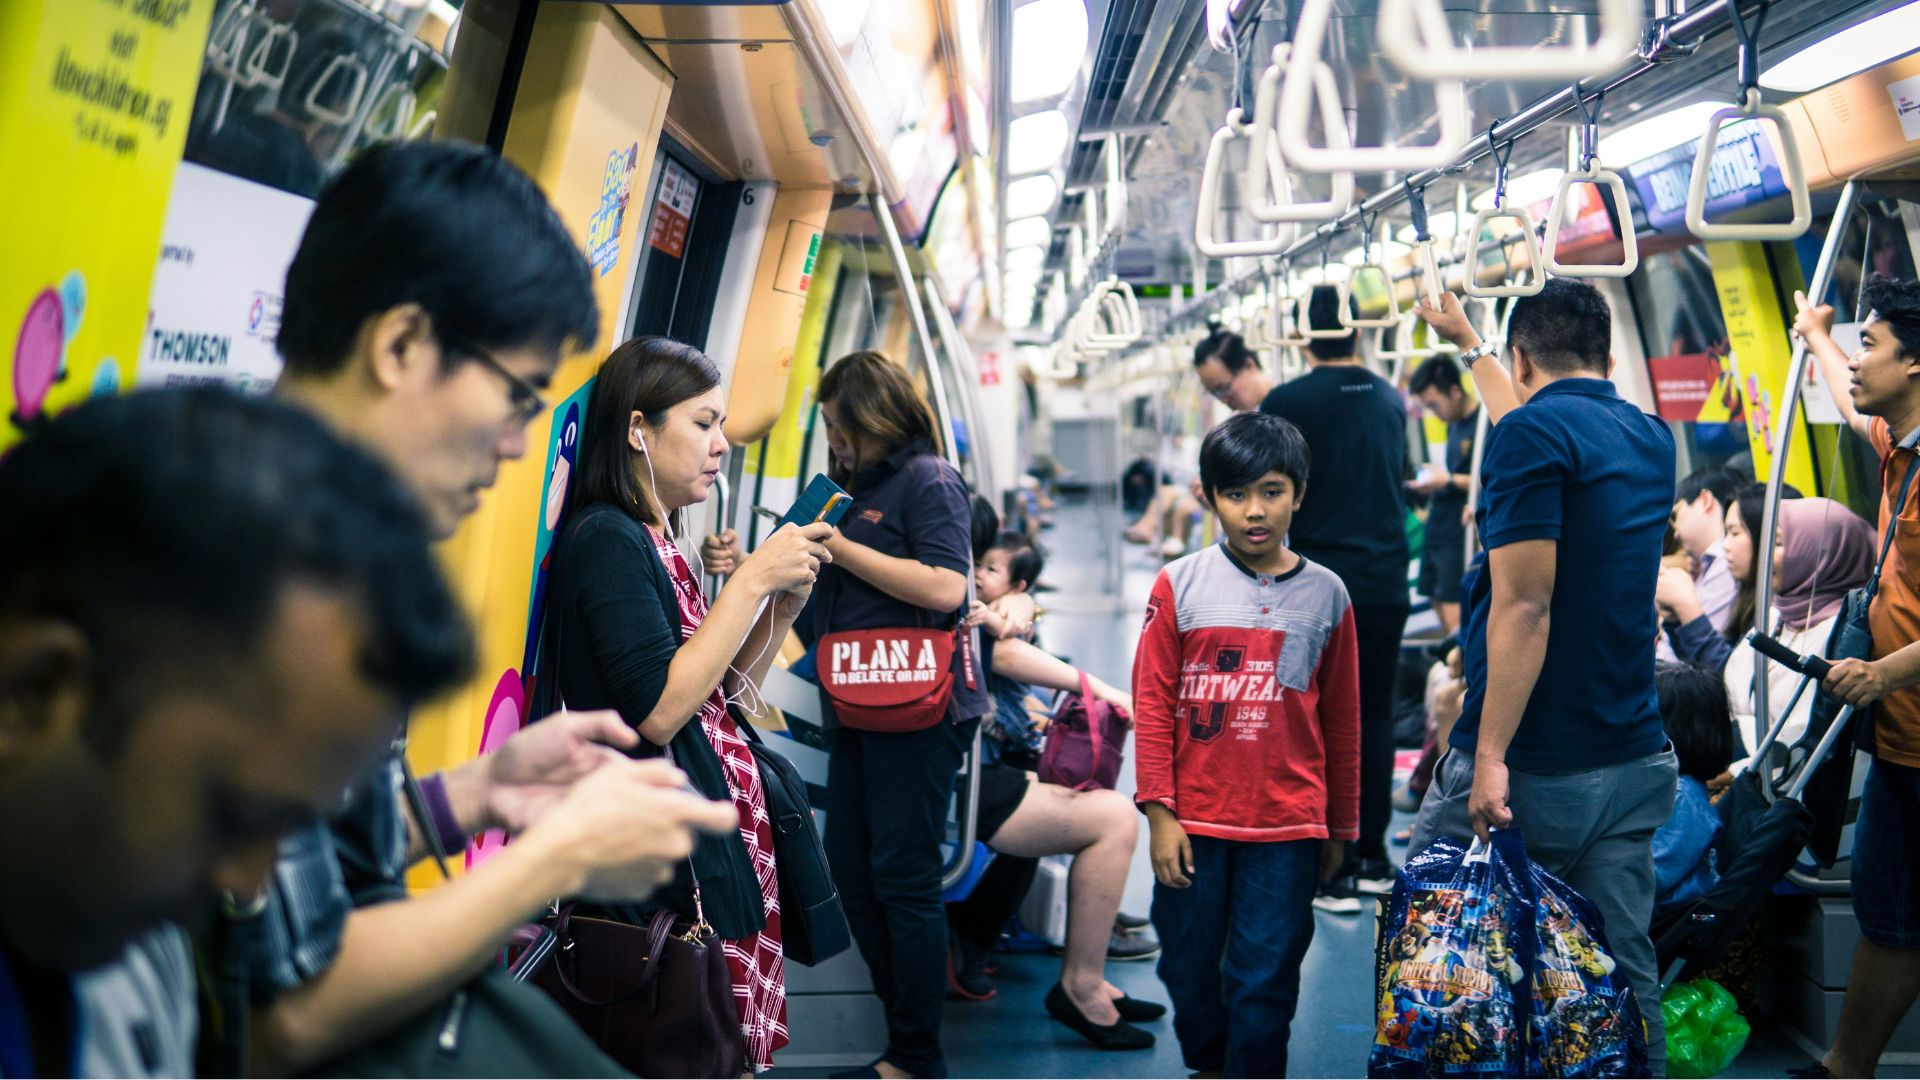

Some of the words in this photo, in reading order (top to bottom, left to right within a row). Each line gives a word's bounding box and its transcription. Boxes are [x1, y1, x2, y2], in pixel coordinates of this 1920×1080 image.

[1649, 161, 1693, 213] BEIN
[1706, 141, 1762, 199] ERTILE
[742, 188, 754, 206] 6
[151, 329, 231, 364] THOMSON
[832, 639, 909, 672] PLAN
[916, 638, 937, 669] A
[1245, 660, 1275, 672] 3105
[831, 672, 846, 685] TO
[848, 670, 895, 684] BELIEVE
[896, 669, 912, 682] OR
[914, 669, 937, 682] NOT
[1235, 705, 1268, 721] 1949
